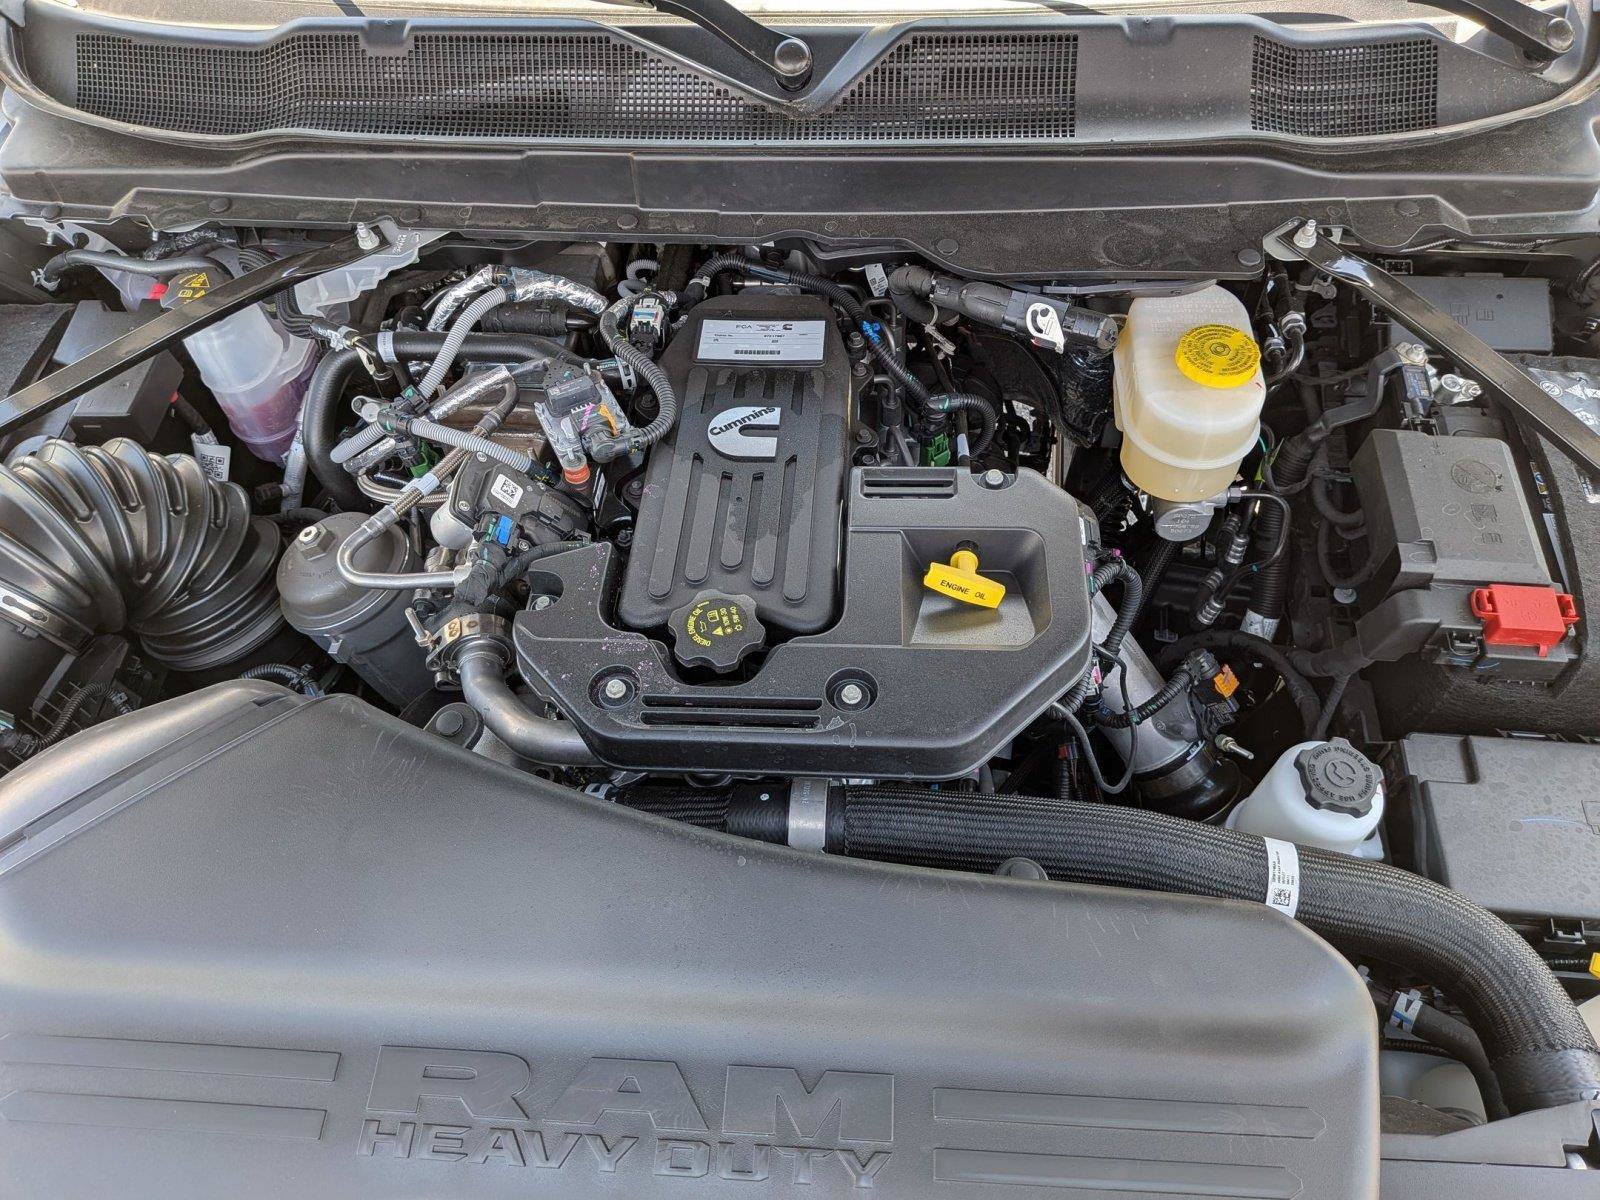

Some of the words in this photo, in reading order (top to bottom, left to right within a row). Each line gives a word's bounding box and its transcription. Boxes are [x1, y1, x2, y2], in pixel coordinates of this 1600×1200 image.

[709, 406, 776, 436] Cummins
[939, 579, 971, 595] ENGINE
[974, 590, 986, 601] OIL
[692, 607, 704, 616] OIL
[364, 1044, 896, 1143] RAM
[356, 1118, 640, 1173] HEAVY
[654, 1137, 894, 1190] DUTY
